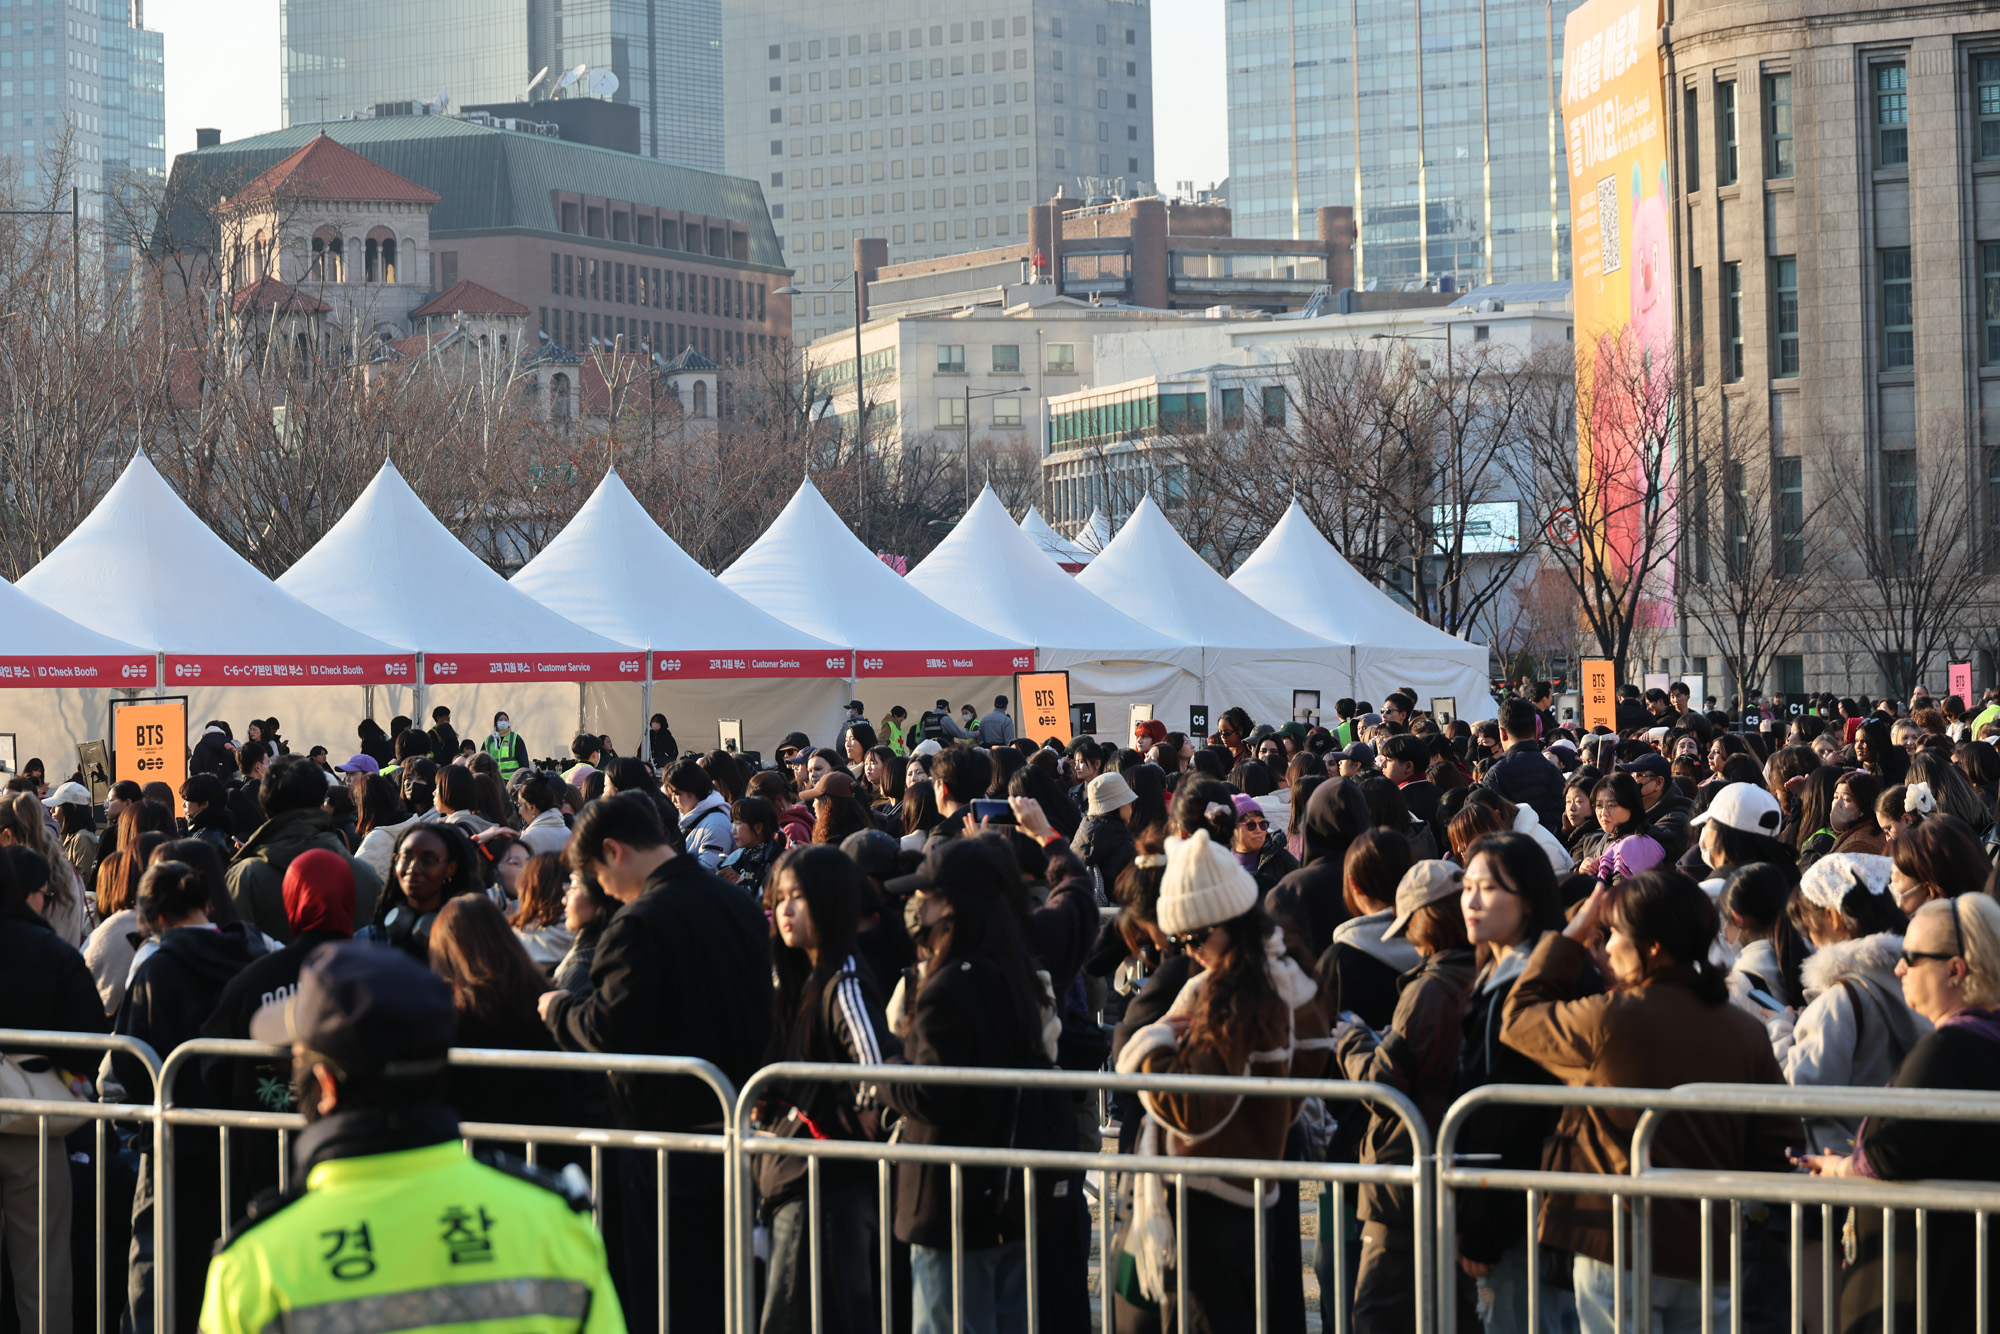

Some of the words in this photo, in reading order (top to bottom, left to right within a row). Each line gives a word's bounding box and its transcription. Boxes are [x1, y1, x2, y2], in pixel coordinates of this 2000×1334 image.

[1568, 31, 1602, 105] 서울을
[1603, 4, 1640, 82] 마음껏
[1635, 88, 1650, 117] Seoul
[1570, 94, 1621, 177] 즐기세요!
[489, 662, 503, 673] 고객
[503, 662, 516, 673] 지원
[517, 662, 530, 673] 부스
[537, 662, 567, 672] Customer
[567, 662, 591, 672] Service
[709, 659, 721, 669] 고객
[734, 659, 746, 669] 부스
[751, 659, 779, 668] Customer
[779, 659, 800, 668] Service
[952, 658, 973, 667] Medical
[13, 666, 31, 678] 부스
[38, 666, 47, 676] ID
[48, 666, 73, 676] Check
[74, 666, 98, 676] Booth
[273, 665, 288, 676] 확인
[288, 665, 303, 676] 부스
[310, 665, 318, 675] ID
[320, 665, 341, 675] Check
[342, 665, 364, 675] Booth
[1592, 674, 1605, 687] BTS
[1035, 690, 1055, 707] BTS
[1790, 703, 1804, 715] C1
[1193, 715, 1205, 725] C6
[1745, 715, 1759, 725] C5
[136, 724, 163, 746] BTS
